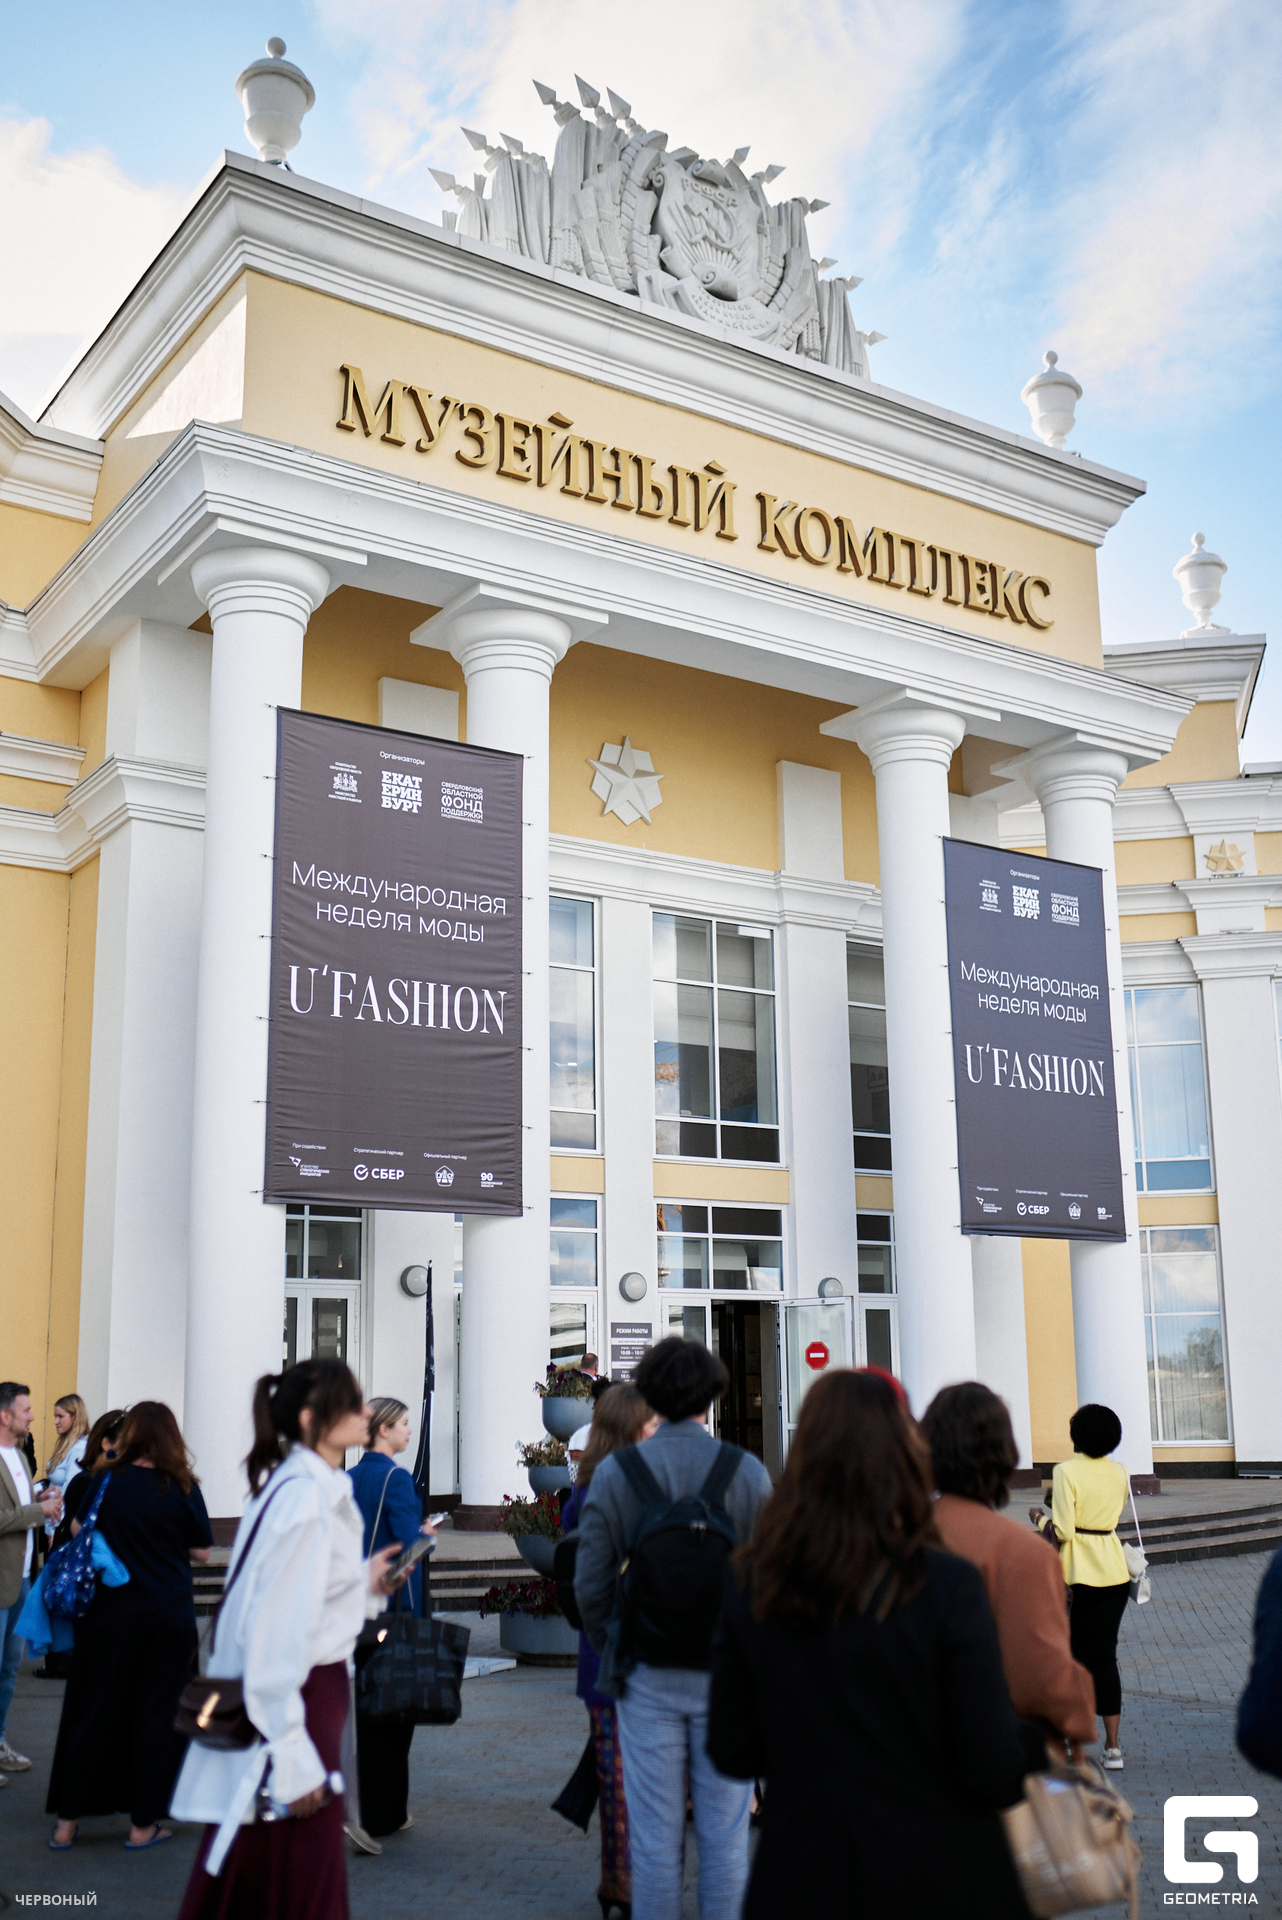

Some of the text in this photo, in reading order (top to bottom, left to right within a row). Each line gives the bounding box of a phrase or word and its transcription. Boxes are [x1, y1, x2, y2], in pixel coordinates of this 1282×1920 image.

[336, 363, 1055, 630] МУЗЕЙНЫЙ КОМПЛЕКС
[379, 750, 426, 766] Организаторы
[381, 770, 423, 789] ЕКАТ
[381, 782, 423, 802] ЕРИН
[441, 787, 484, 801] ОБЛАСТНОЙ
[381, 795, 423, 814] БУРГ
[441, 794, 484, 814] ФОНД
[440, 806, 484, 820] ПОДДЕРЖКИ
[292, 860, 506, 916] Международная
[1012, 885, 1040, 900] ЕКАТ
[1013, 895, 1040, 910] ЕРИН
[1051, 903, 1080, 918] ФОНД
[316, 901, 484, 943] неделя моды
[960, 960, 1100, 1000] Международная
[978, 993, 1087, 1024] неделя моды
[371, 1167, 405, 1181] СБЕР
[480, 1172, 494, 1181] 90
[1027, 1204, 1050, 1215] СБЕР
[1097, 1207, 1107, 1215] 90
